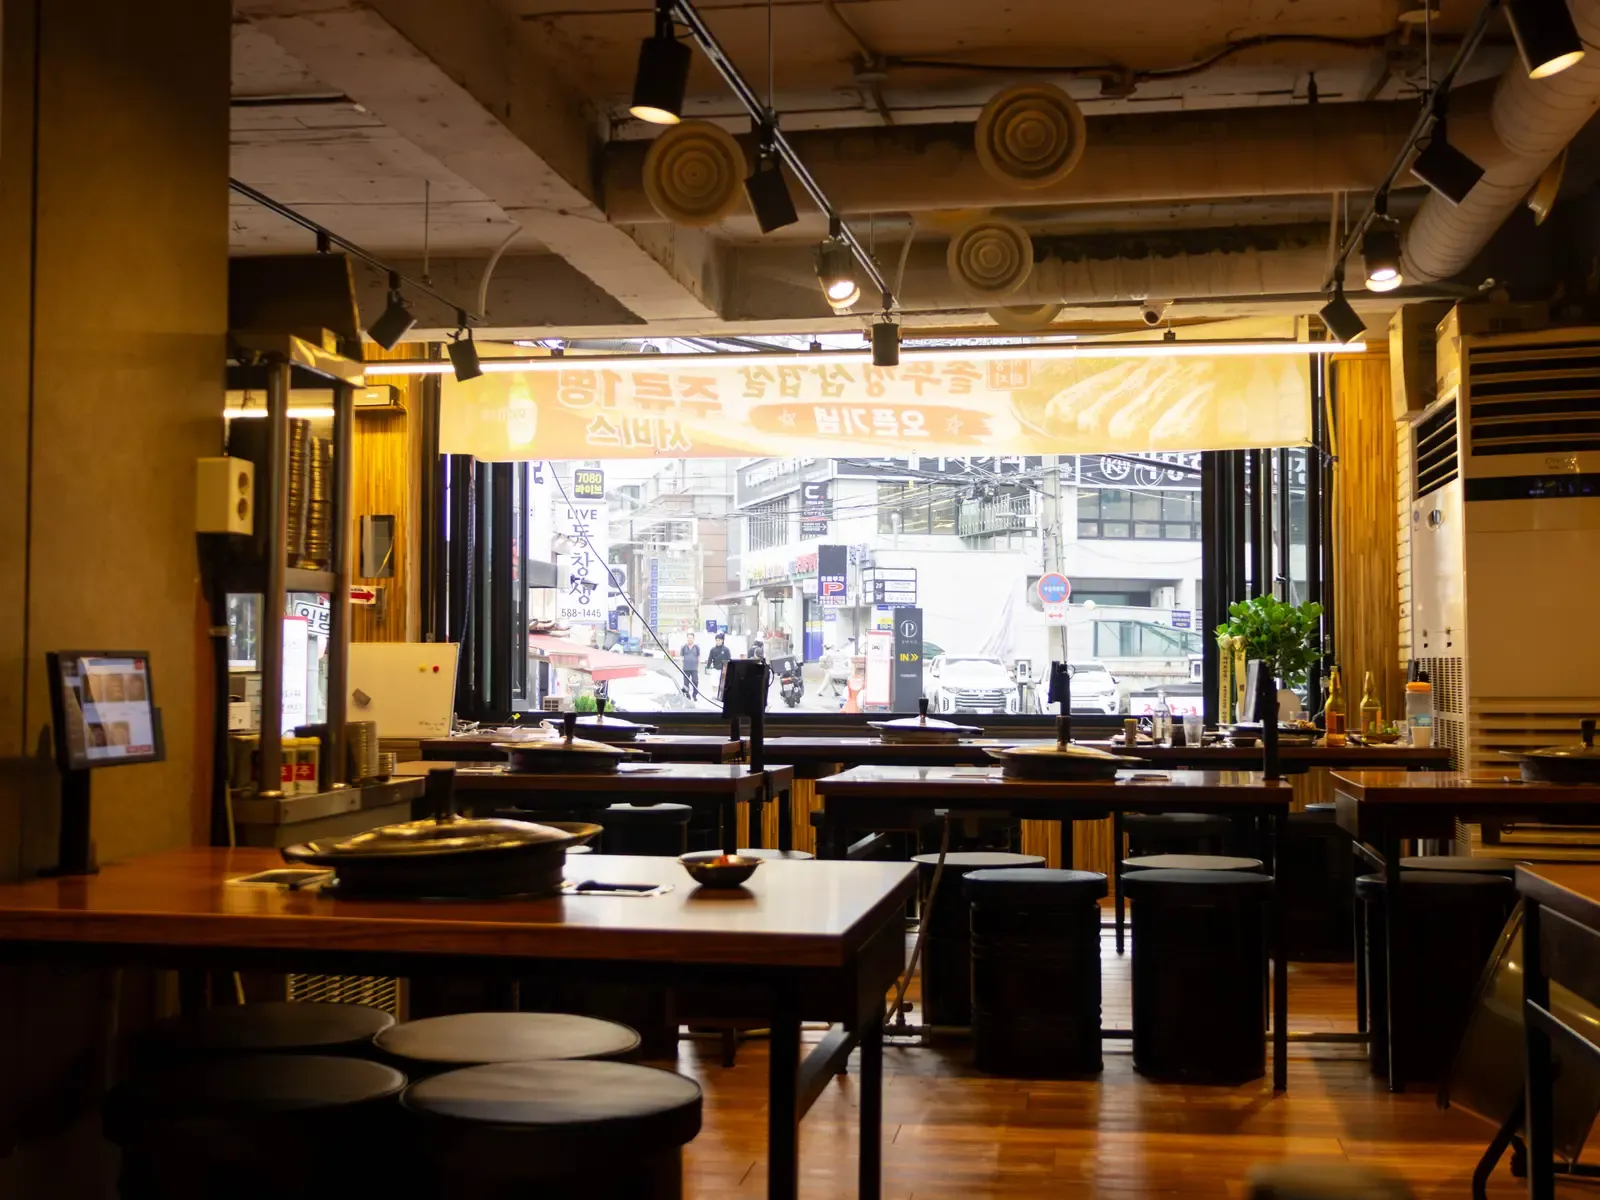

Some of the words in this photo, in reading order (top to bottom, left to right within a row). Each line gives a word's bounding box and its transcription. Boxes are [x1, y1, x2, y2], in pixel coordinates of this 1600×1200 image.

[577, 472, 602, 483] 7080
[575, 484, 602, 495] 라이브
[567, 509, 598, 520] LIVE
[823, 582, 844, 595] P
[561, 608, 602, 618] 588-1445
[900, 653, 909, 661] IN
